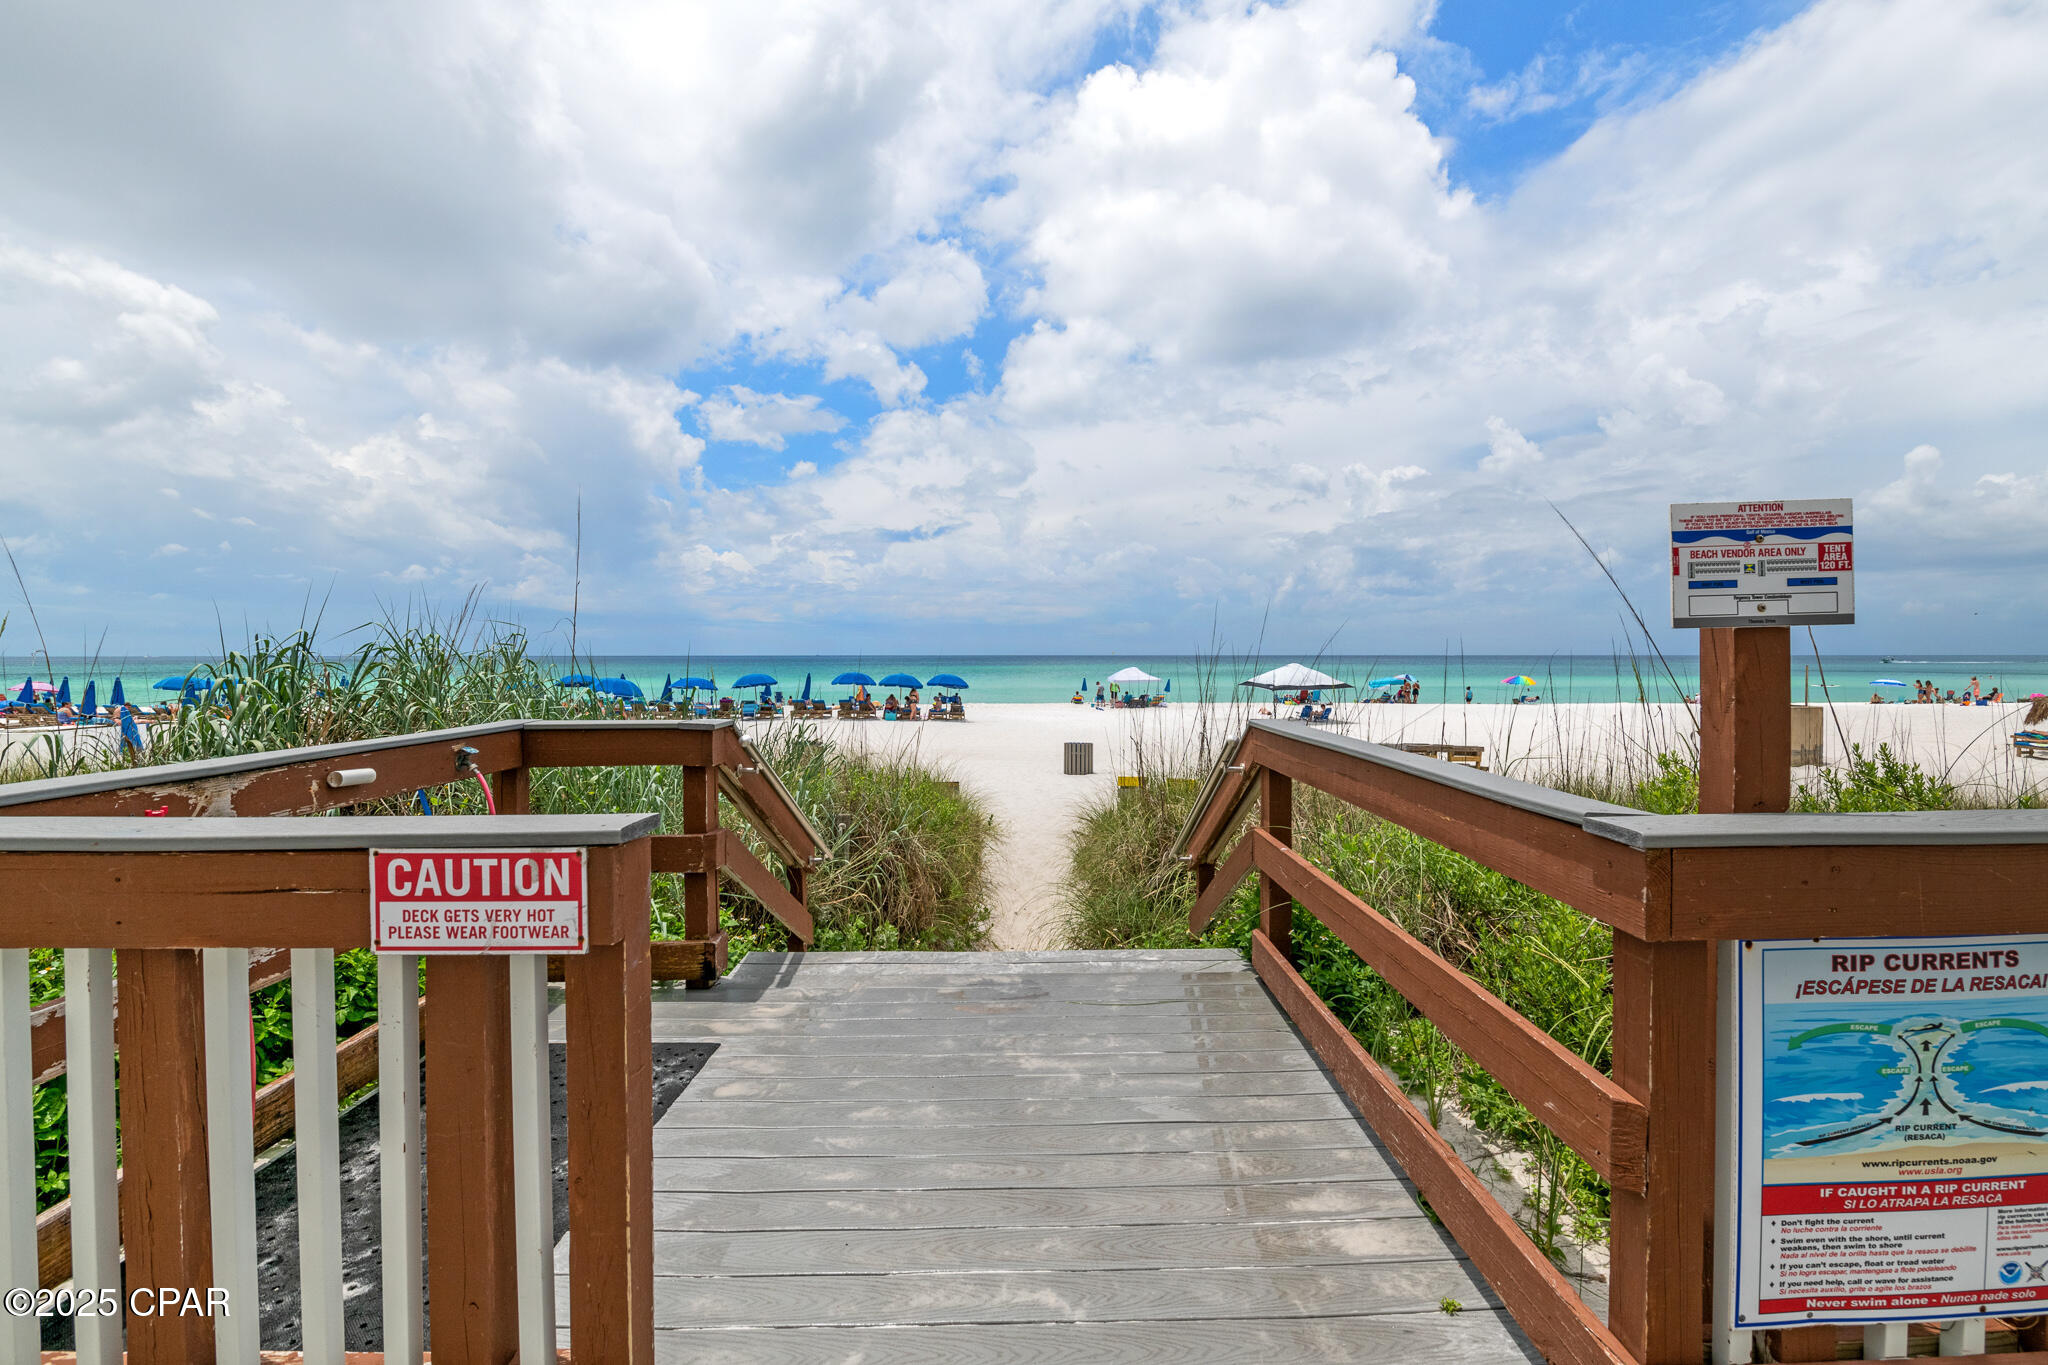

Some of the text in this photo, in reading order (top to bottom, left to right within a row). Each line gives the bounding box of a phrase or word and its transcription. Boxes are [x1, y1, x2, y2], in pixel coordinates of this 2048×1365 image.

[1738, 504, 1783, 512] ATTENTION
[1690, 547, 1807, 559] BEACH VENDOR AREA ONLY
[1824, 544, 1846, 552] TENT
[1823, 553, 1848, 561] AREA
[1838, 561, 1851, 569] FT.
[388, 858, 570, 896] CAUTION
[402, 909, 555, 923] DECK GETS VERY HOT
[388, 926, 570, 940] PLEASE WEAR FOOTWEAR
[1831, 950, 2020, 972] RIP CURRENTS
[1796, 973, 2048, 998] ¡ESCÁPESE DE LA RESACA!
[1913, 1123, 1958, 1131] CURRENT
[1904, 1133, 1945, 1142] (RESACA)
[1862, 1156, 1997, 1168] www.ripcurrents.noaa.gov
[1899, 1166, 1962, 1176] www.usla.org
[1820, 1180, 2028, 1198] IF CAUGHT IN A RIP CURRENT
[1843, 1194, 2003, 1210] SI LO ATRAPA LA RESACA
[1805, 1219, 1824, 1227] fight
[1865, 1235, 1891, 1243] shore,
[1780, 1244, 1820, 1253] weakens,
[1825, 1279, 1845, 1287] help,
[1806, 1297, 1847, 1307] Never
[1851, 1296, 1887, 1306] swim
[1891, 1294, 1929, 1304] alone
[1941, 1292, 1978, 1302] Nunca
[1980, 1291, 2009, 1300] nade
[2012, 1289, 2037, 1299] solo
